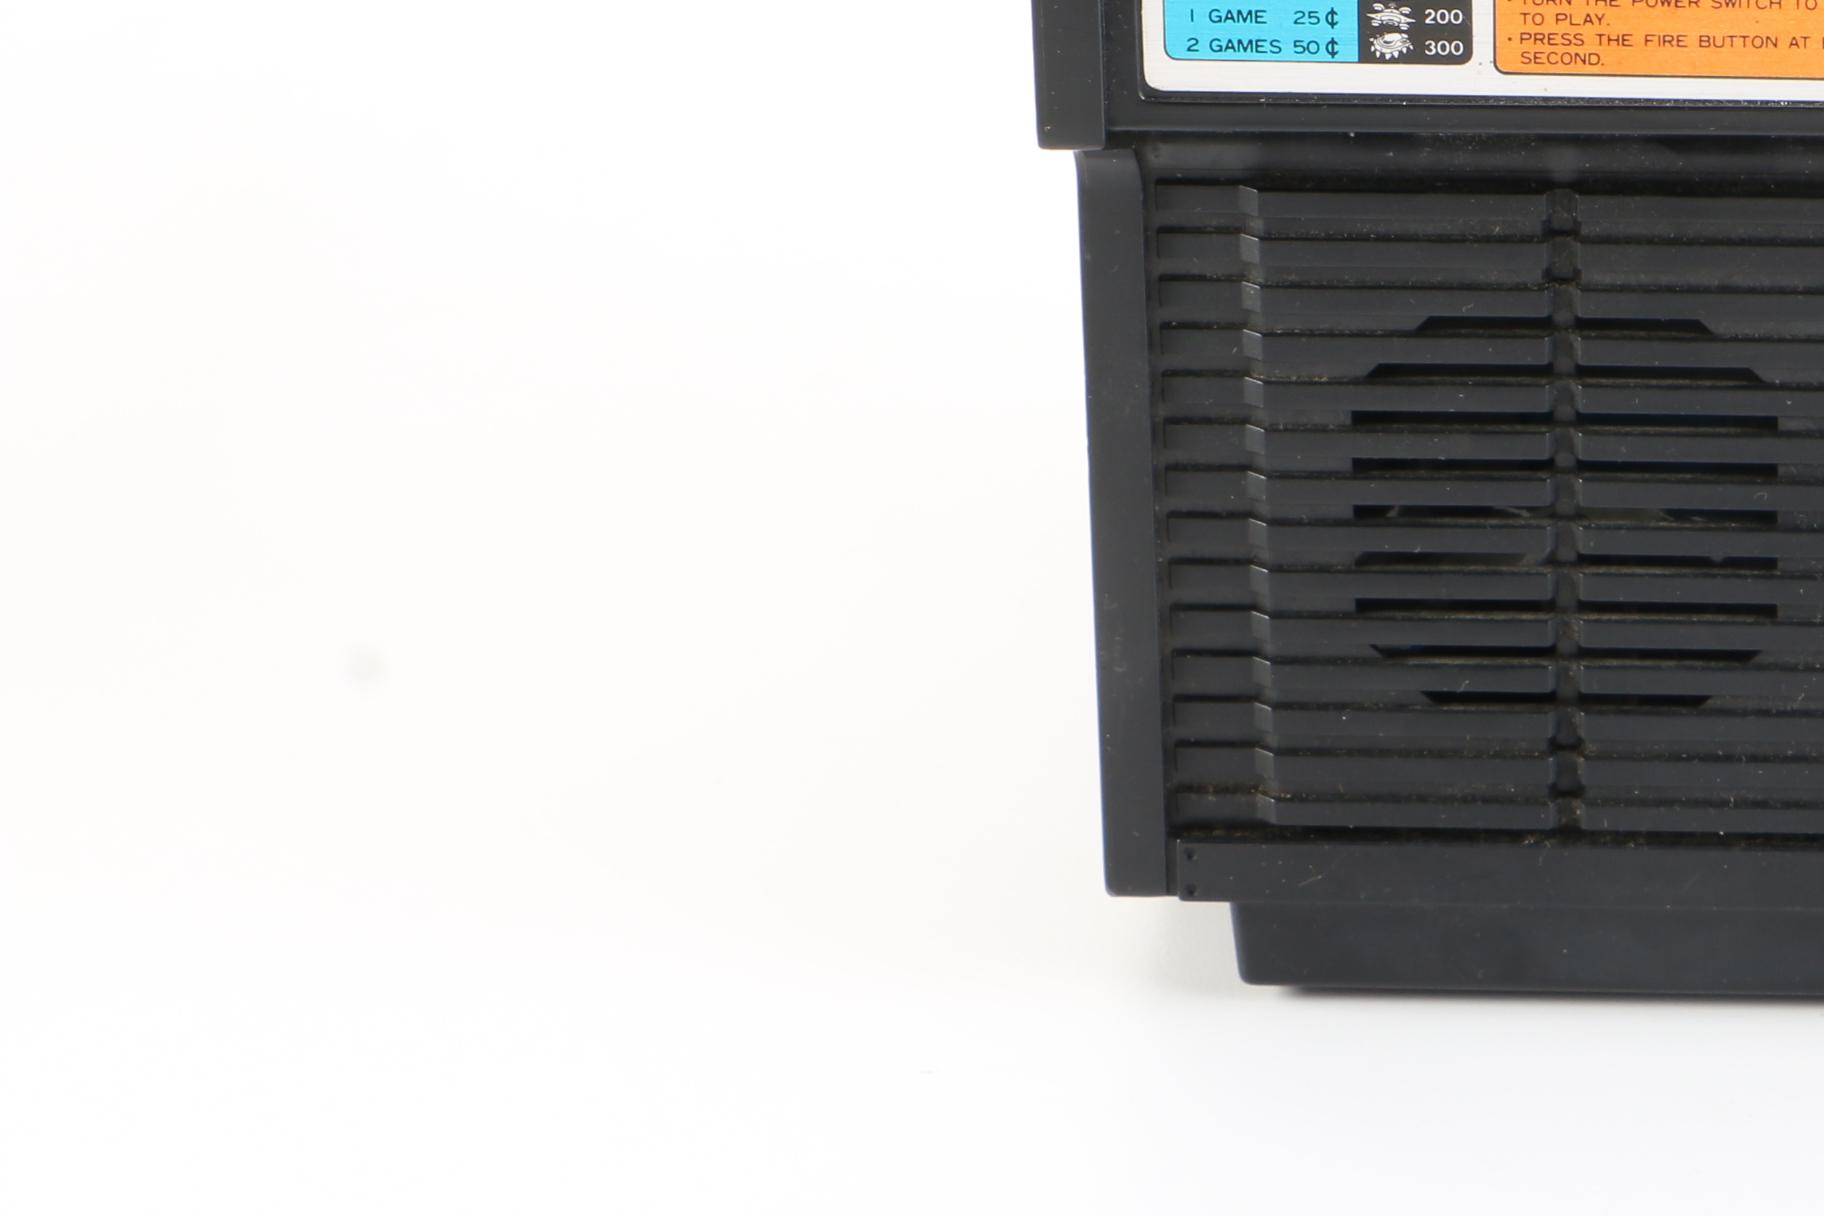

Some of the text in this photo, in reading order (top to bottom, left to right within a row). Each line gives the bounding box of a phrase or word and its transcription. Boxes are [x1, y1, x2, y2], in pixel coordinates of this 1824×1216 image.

[1209, 10, 1267, 24] GAME
[1425, 9, 1463, 25] 200
[1520, 12, 1610, 26] TO PLAY.
[1187, 39, 1200, 52] 2
[1209, 40, 1282, 54] GAMES
[1425, 41, 1464, 56] 300
[1520, 33, 1584, 46] PRESS
[1596, 34, 1634, 47] THE
[1645, 35, 1688, 48] FIRE
[1699, 36, 1777, 48] BUTTON
[1788, 37, 1811, 49] AT
[1520, 52, 1604, 66] SECOND.
